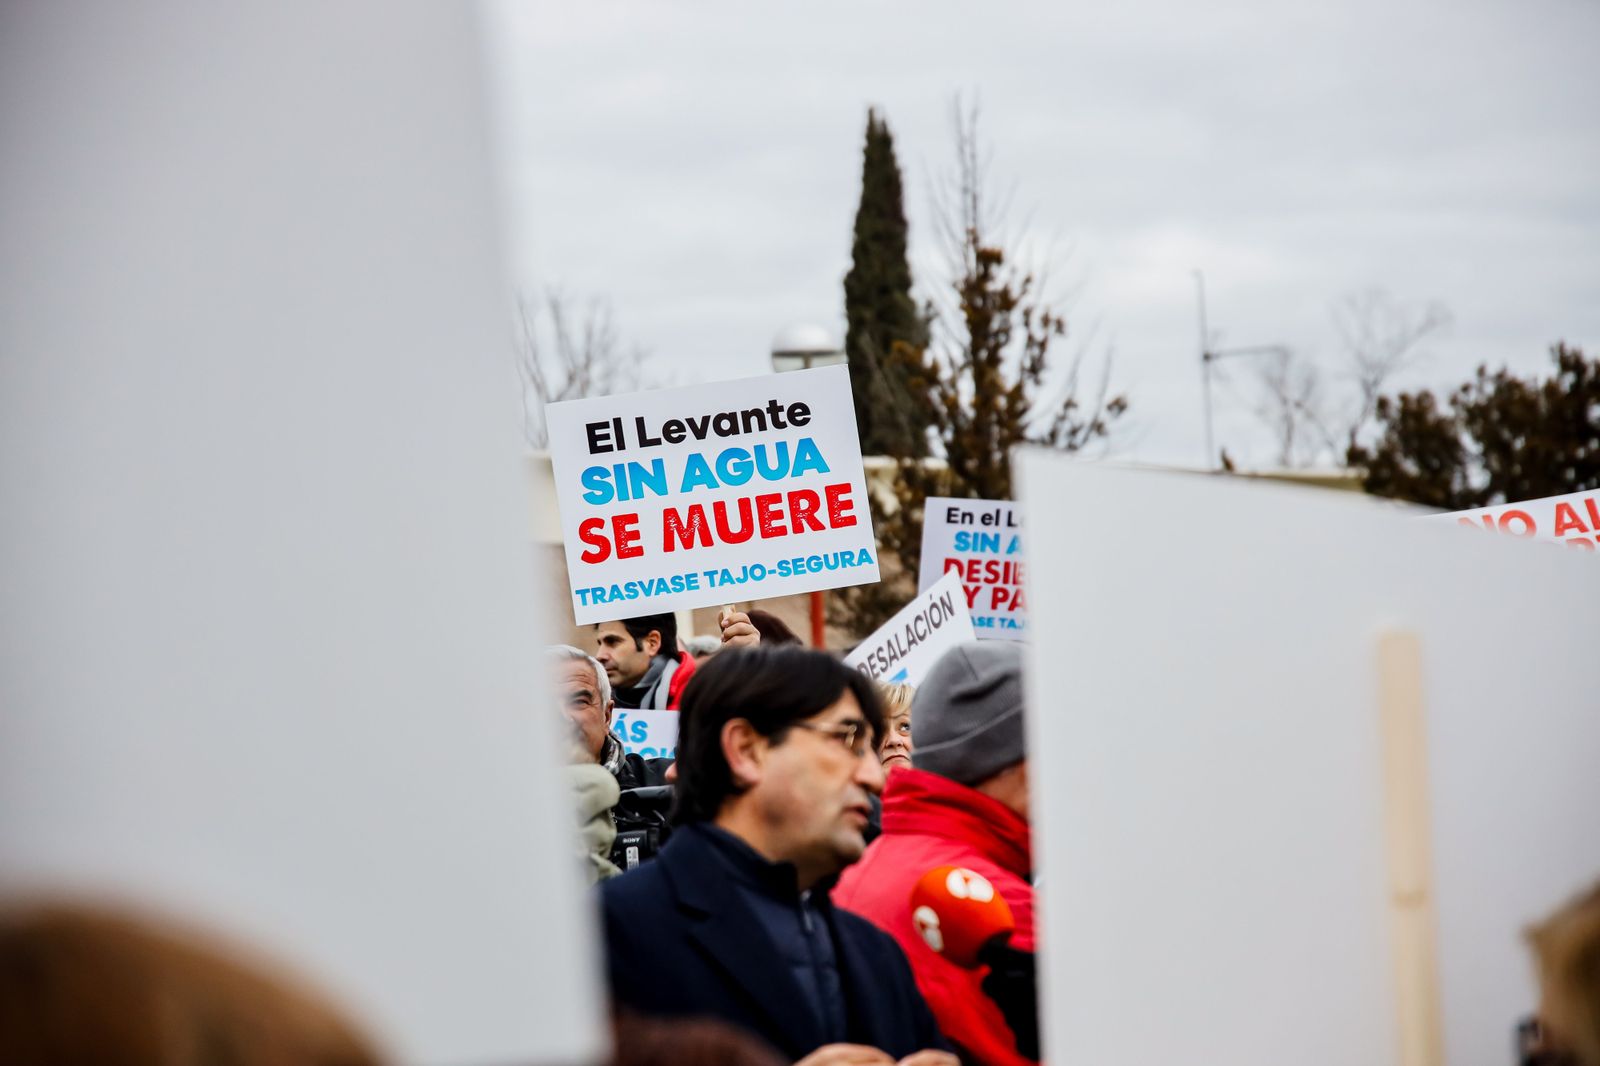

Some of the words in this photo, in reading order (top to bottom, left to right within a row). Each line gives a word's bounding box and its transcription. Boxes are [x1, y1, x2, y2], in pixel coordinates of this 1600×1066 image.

[585, 417, 626, 455] El
[635, 399, 812, 448] Levante
[580, 458, 668, 506] SIN
[680, 437, 831, 493] AGUA
[578, 512, 644, 565] SE
[662, 482, 858, 553] MUERE
[946, 507, 974, 525] En
[981, 508, 1000, 527] el
[1007, 511, 1021, 528] L
[954, 531, 1000, 554] SIN
[575, 572, 700, 607] TRASVASE
[703, 548, 874, 589] TAJO-SEGURA
[962, 585, 982, 609] Y
[856, 590, 955, 680] DESALACIÓN
